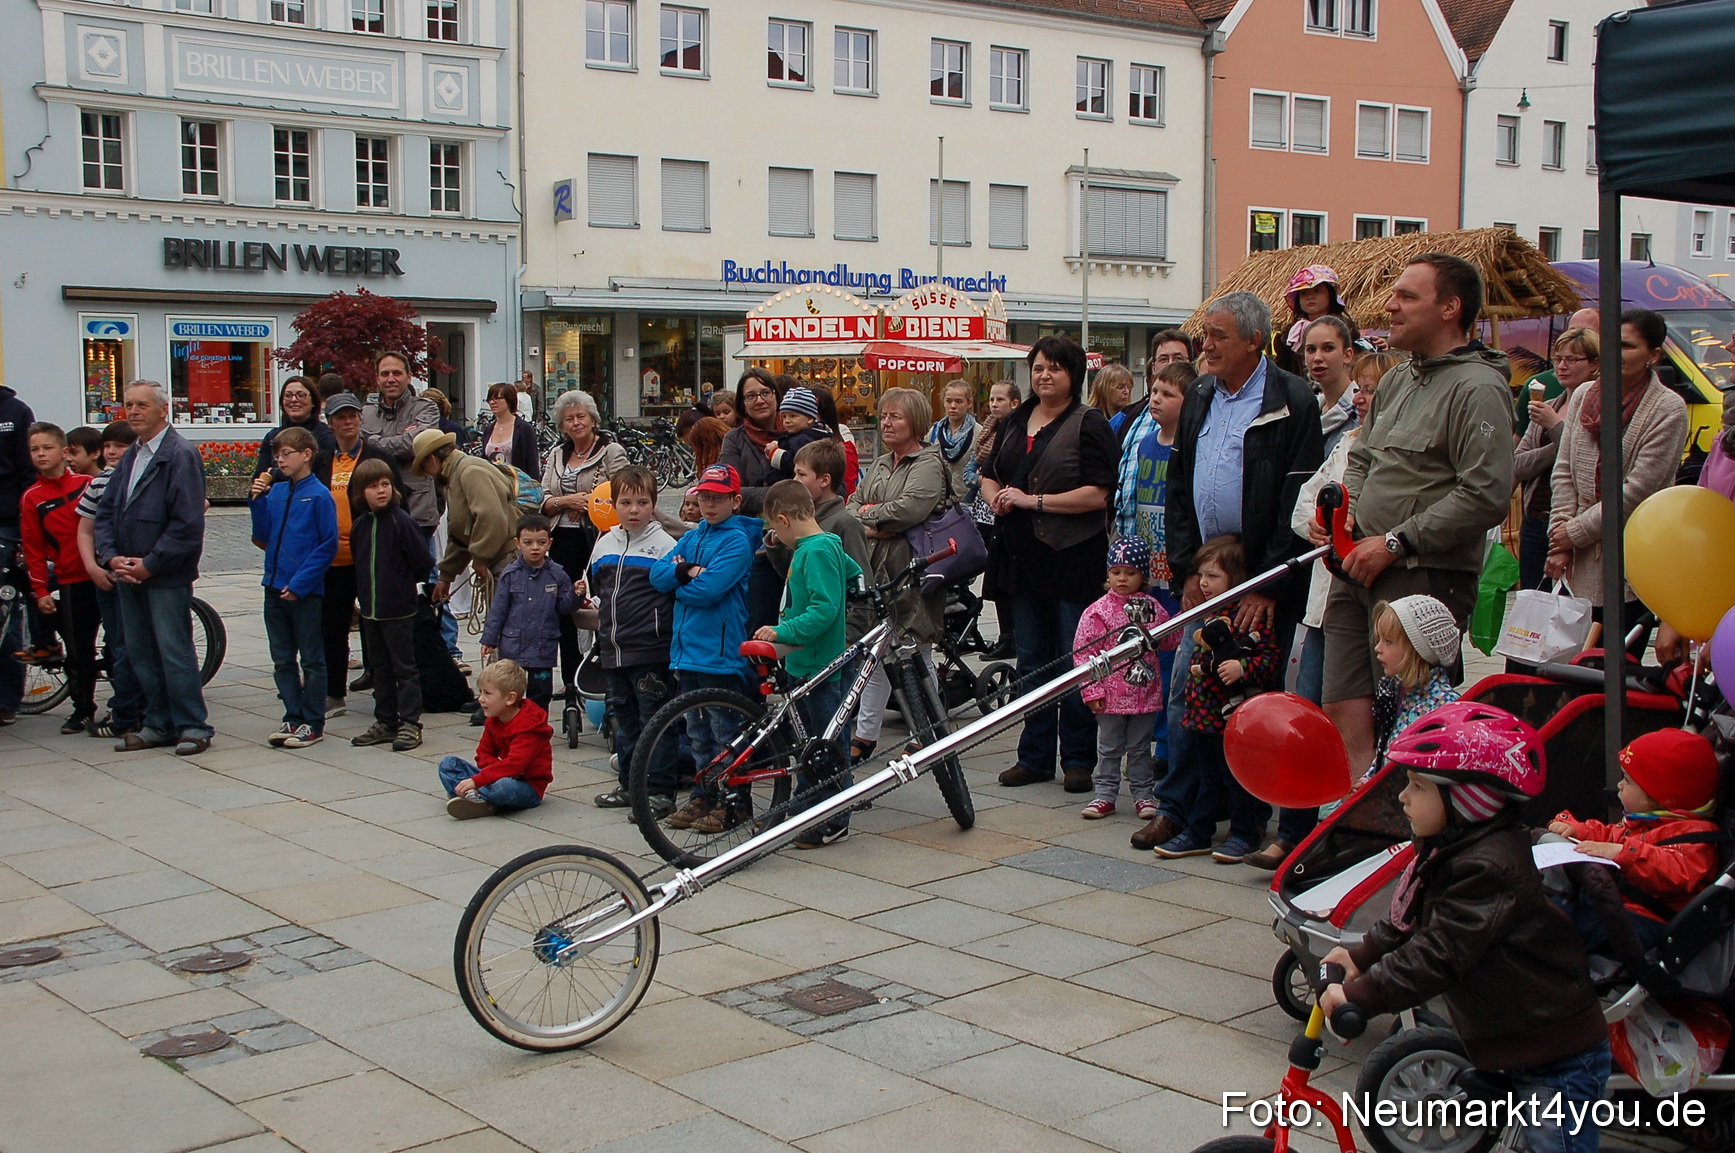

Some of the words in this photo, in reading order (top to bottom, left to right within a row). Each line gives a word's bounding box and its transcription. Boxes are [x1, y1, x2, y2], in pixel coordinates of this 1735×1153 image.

[186, 51, 290, 85] BRILLEN
[295, 62, 387, 95] WEBER
[554, 184, 572, 216] R
[164, 237, 288, 272] BRILLEN
[293, 244, 406, 276] WEBER
[723, 259, 892, 294] Buchhandlung
[178, 323, 223, 335] BRILLEN
[225, 325, 265, 337] WEBER
[749, 317, 875, 340] MANDELN
[905, 317, 971, 338] BIENE
[878, 358, 945, 372] POPCORN
[836, 658, 875, 725] CUBE
